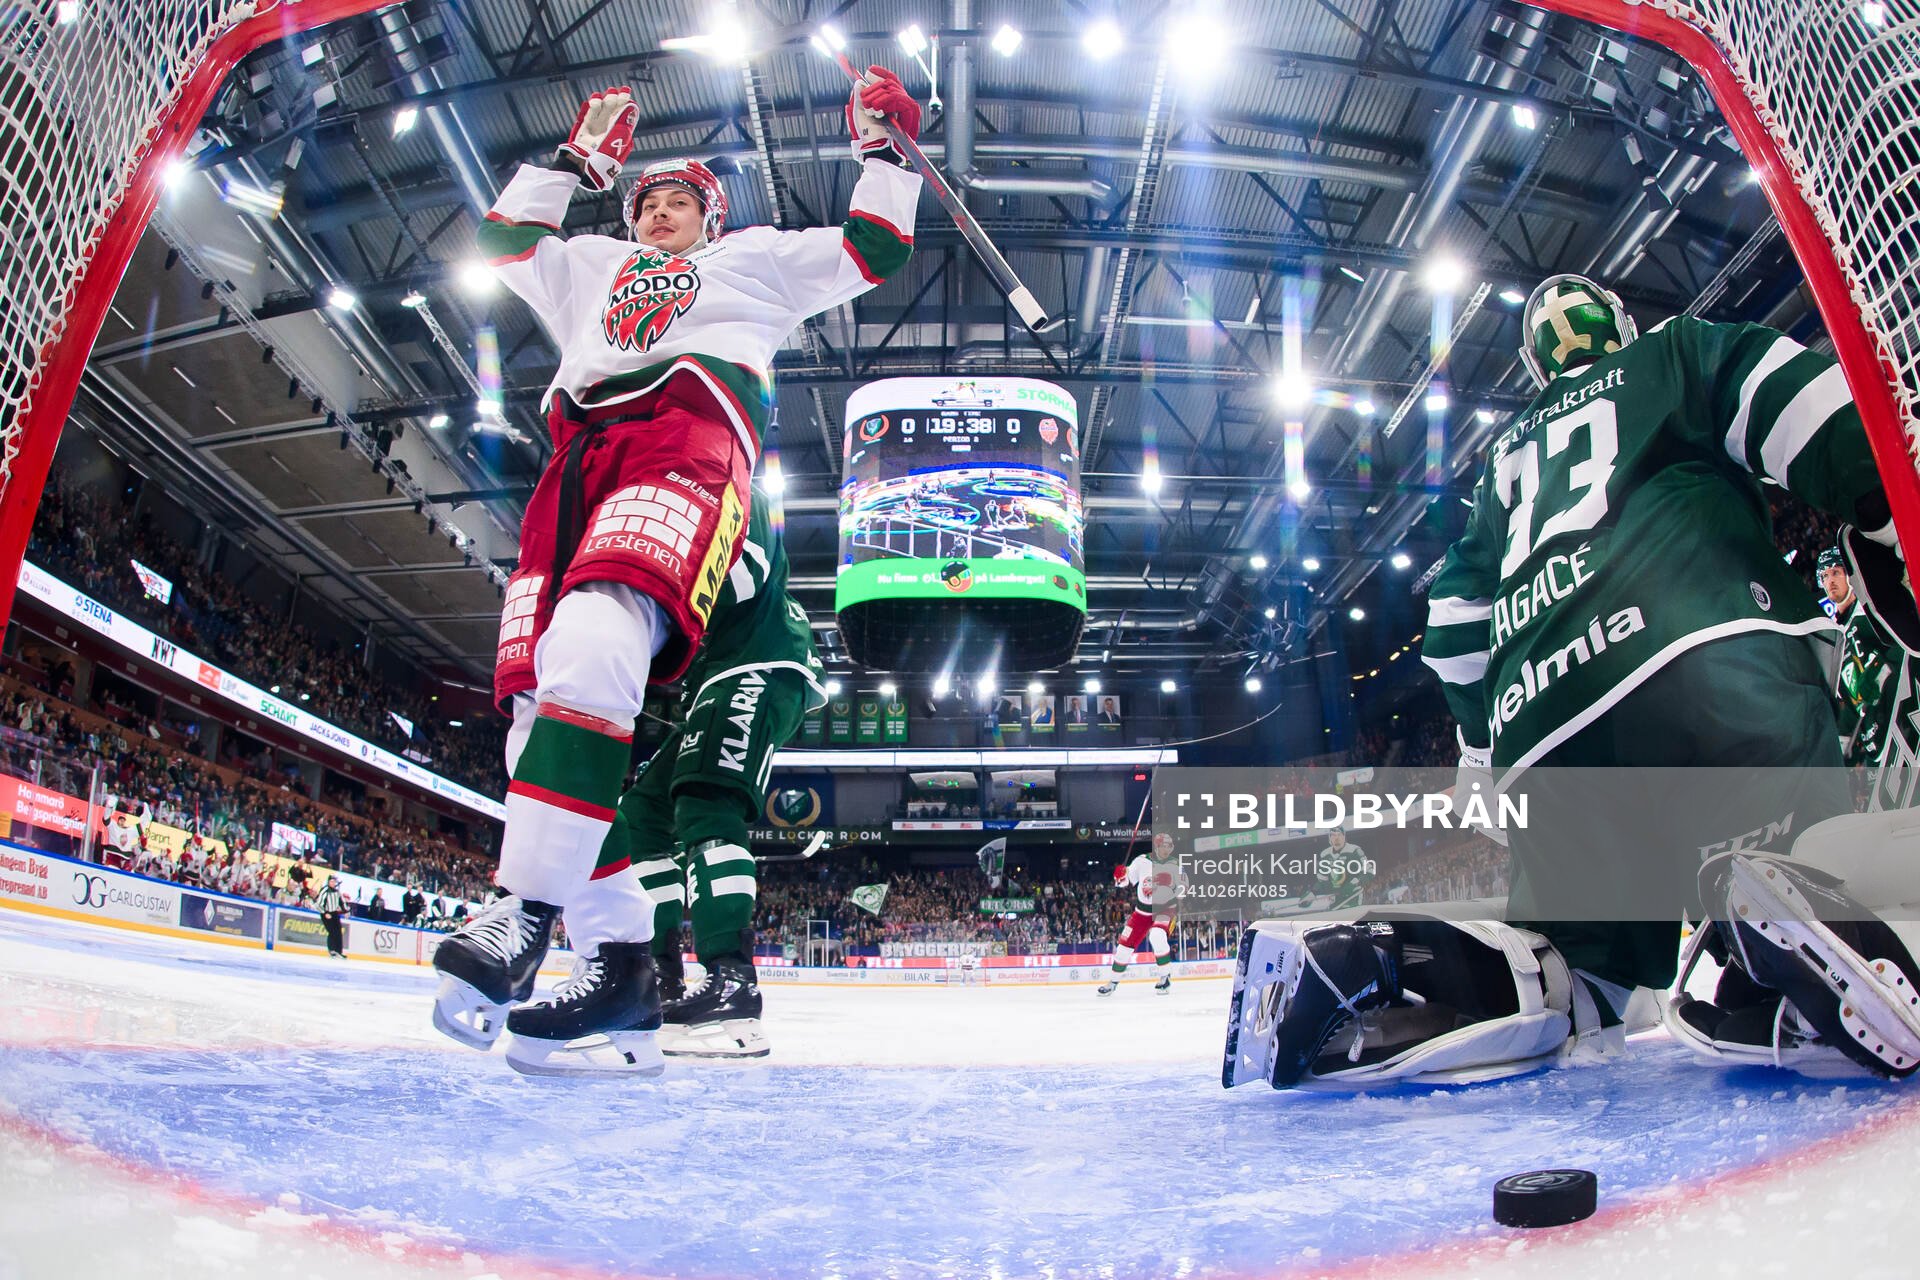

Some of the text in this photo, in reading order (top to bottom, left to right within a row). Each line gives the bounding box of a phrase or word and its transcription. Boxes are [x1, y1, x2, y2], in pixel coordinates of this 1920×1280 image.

[610, 274, 695, 307] MODO
[611, 291, 686, 331] HOCKEY
[901, 418, 916, 434] 0
[930, 418, 993, 433] 19:38
[1006, 418, 1021, 434] 0
[584, 533, 682, 576] Lerstenen.
[83, 599, 113, 625] STENA
[151, 636, 177, 667] NWT
[260, 699, 298, 726] SCHAKT
[747, 830, 882, 840] THE LOCKR ROOM
[1095, 829, 1111, 837] The
[1225, 834, 1252, 848] print
[284, 918, 346, 937] FINNFO
[1023, 956, 1061, 967] FLEX
[760, 969, 799, 978] HÖJDENS
